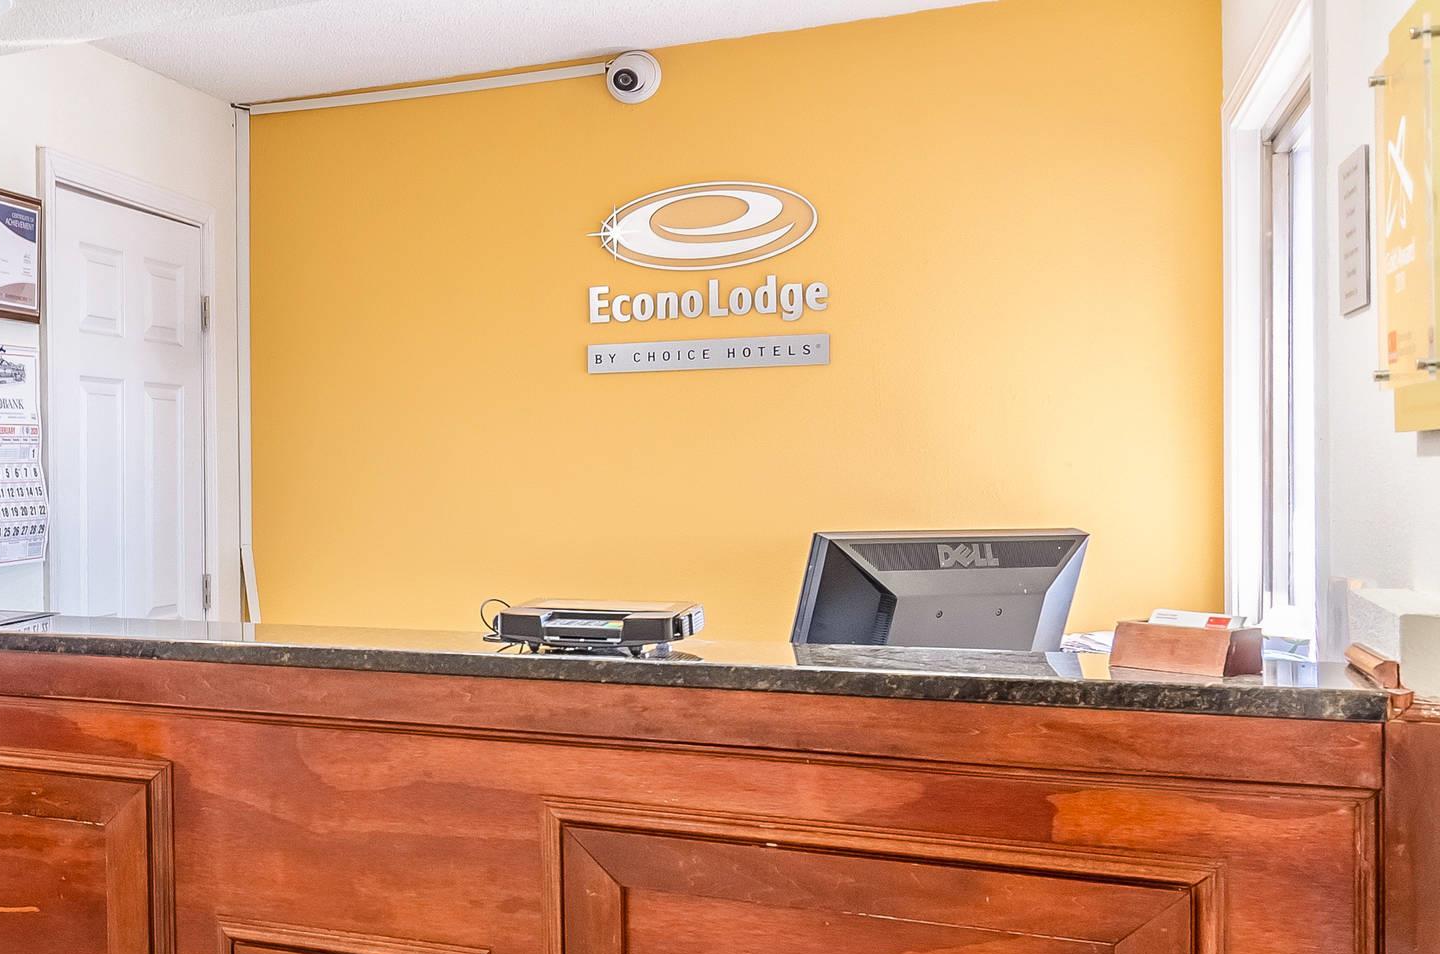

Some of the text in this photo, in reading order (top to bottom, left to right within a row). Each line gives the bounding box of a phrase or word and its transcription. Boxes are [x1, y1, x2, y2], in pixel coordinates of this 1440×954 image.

[589, 275, 829, 325] EconoLodge
[595, 344, 812, 364] BY CHOICE HOTELS
[5, 468, 10, 478] 5
[14, 468, 20, 478] 6
[23, 467, 28, 477] 7
[33, 467, 38, 477] 8
[7, 487, 15, 497] 12
[16, 487, 24, 497] 13
[26, 487, 34, 496] 14
[35, 486, 43, 496] 15
[1, 507, 9, 517] 18
[11, 506, 19, 516] 19
[20, 506, 28, 516] 20
[29, 505, 37, 515] 21
[39, 505, 46, 515] 22
[3, 527, 11, 537] 25
[20, 525, 28, 535] 27
[937, 543, 1000, 568] DELL
